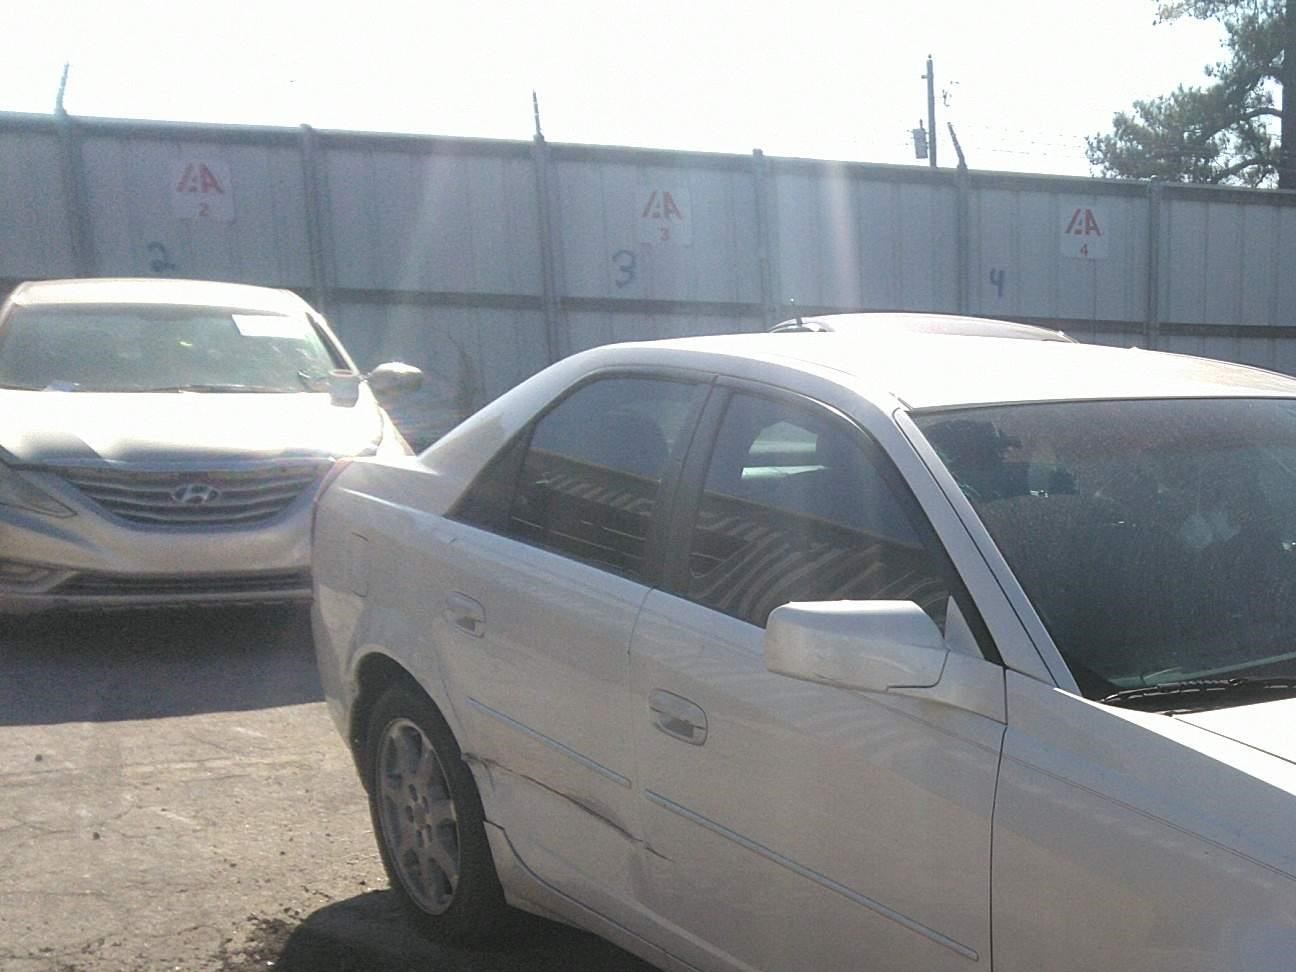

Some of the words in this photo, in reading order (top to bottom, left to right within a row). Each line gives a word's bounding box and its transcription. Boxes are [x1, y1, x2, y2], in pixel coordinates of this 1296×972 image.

[1080, 243, 1089, 257] 4
[612, 250, 638, 290] 3
[989, 268, 1005, 299] 4
